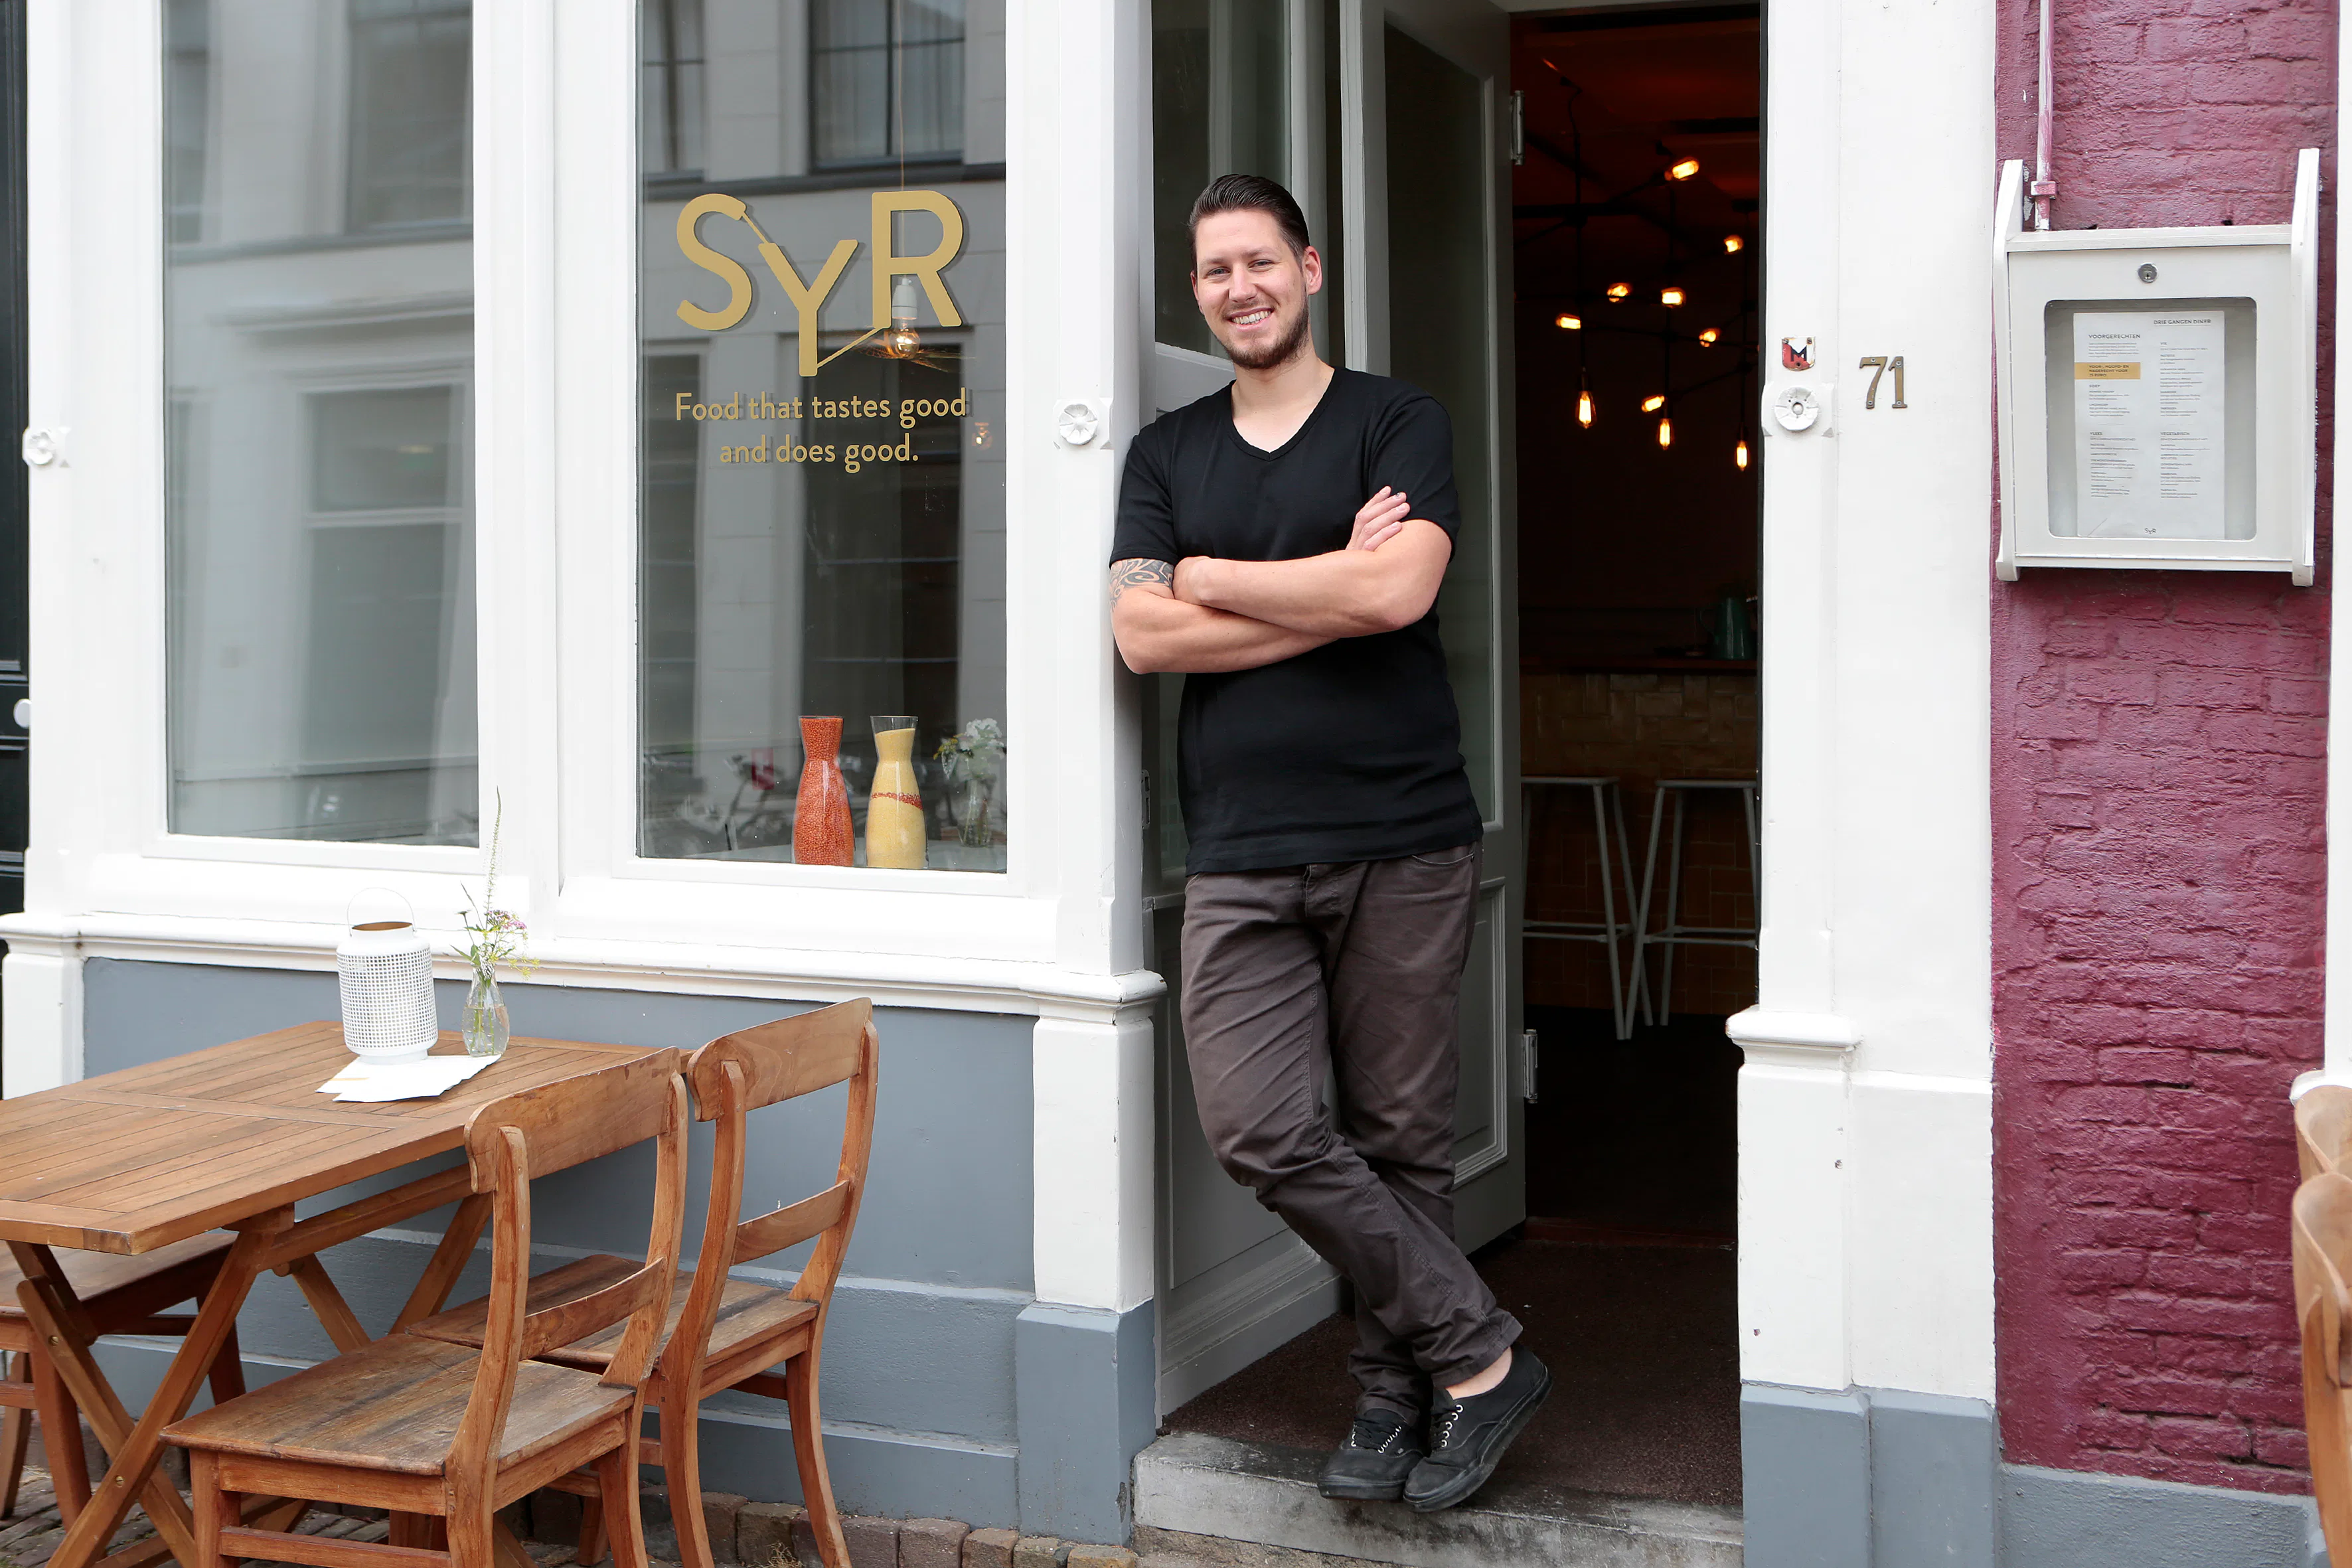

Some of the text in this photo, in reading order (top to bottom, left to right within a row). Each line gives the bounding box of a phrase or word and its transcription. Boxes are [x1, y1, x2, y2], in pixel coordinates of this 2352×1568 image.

[1859, 356, 1908, 409] 71
[676, 387, 966, 429] Food that tastes good
[720, 432, 918, 473] and does good.
